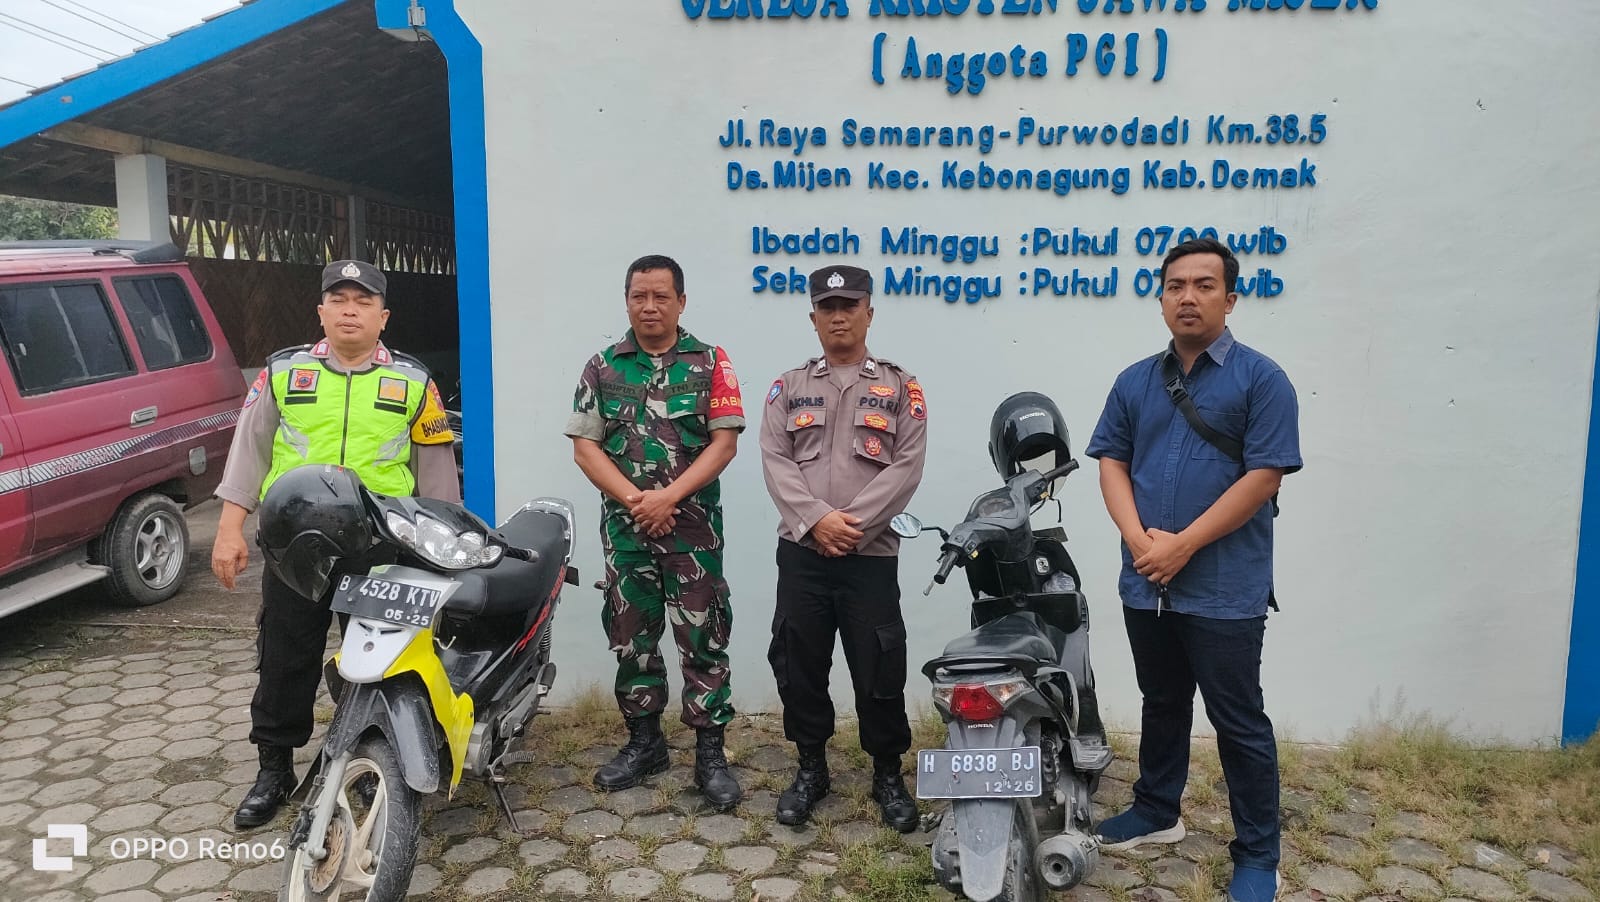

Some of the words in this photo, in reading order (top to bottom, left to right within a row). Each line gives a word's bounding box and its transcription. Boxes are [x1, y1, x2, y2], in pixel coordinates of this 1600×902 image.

[868, 162, 929, 190] Kec.
[941, 160, 1130, 196] Kebonagung
[752, 226, 860, 255] Ibadah
[881, 226, 999, 264] Minggu
[1227, 225, 1287, 255] wib
[883, 265, 1002, 304] Minggu
[788, 396, 825, 411] AKHLIS
[859, 396, 899, 414] POLRI
[339, 575, 351, 591] B
[359, 578, 401, 601] 4528
[405, 586, 440, 608] KTV
[924, 754, 935, 773] H
[951, 754, 997, 773] 6838
[1011, 752, 1035, 771] BJ
